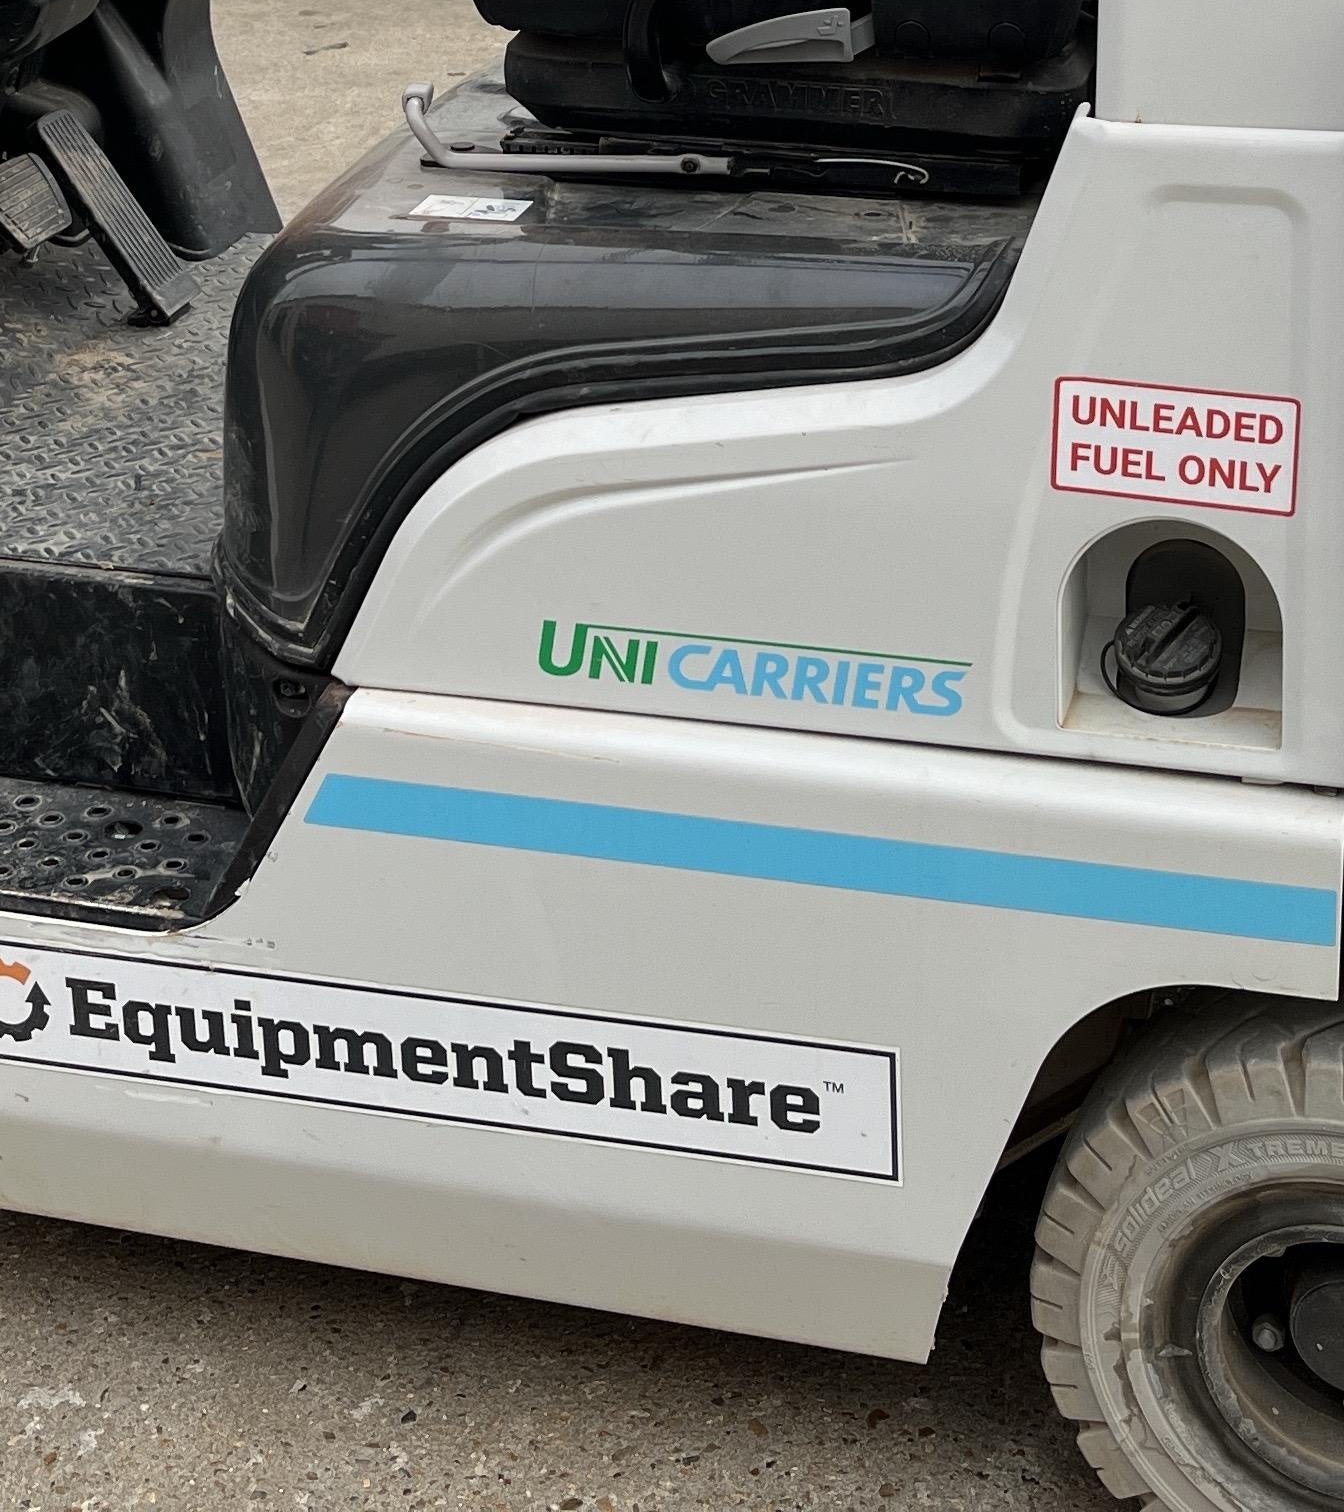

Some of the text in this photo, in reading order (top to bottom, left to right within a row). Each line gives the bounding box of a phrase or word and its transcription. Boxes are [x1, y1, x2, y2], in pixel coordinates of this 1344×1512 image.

[1071, 395, 1284, 446] UNLEADED
[1070, 443, 1283, 497] FUEL ONLY
[539, 619, 973, 716] UNICARRIERS
